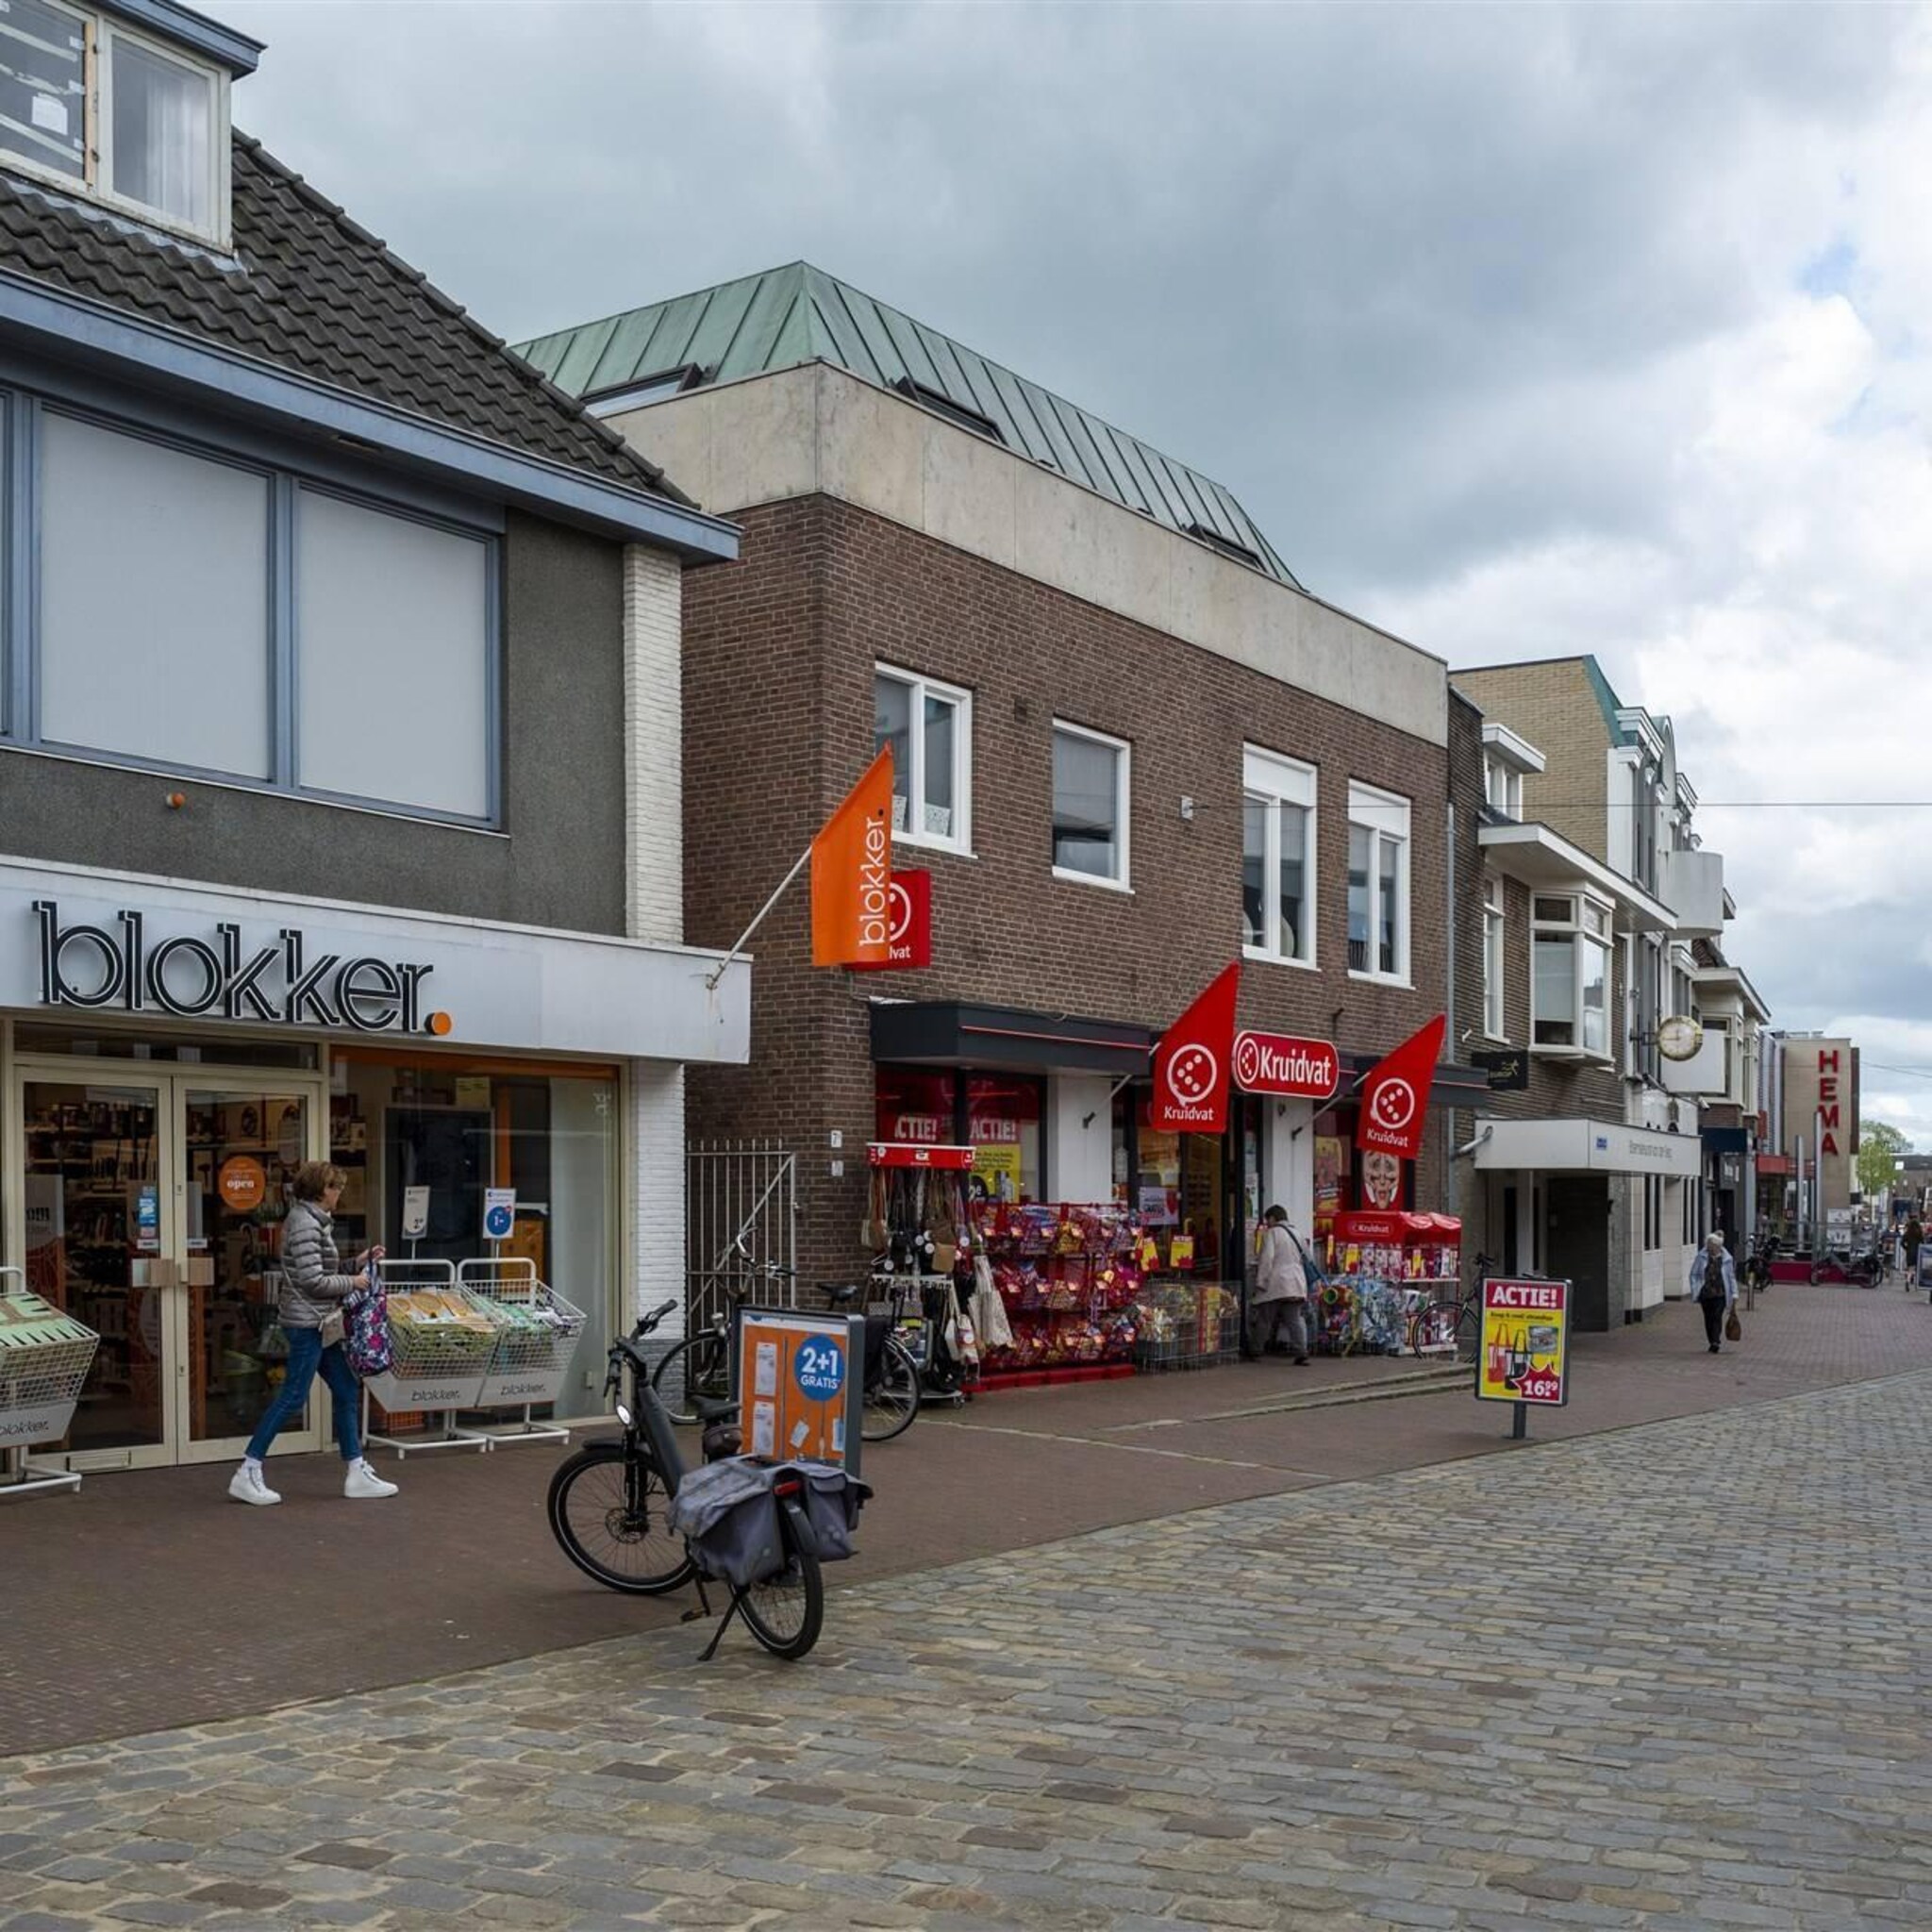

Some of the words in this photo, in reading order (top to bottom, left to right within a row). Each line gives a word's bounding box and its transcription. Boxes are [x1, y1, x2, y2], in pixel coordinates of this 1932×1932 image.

[1260, 1045, 1331, 1085] Kruidvat
[1164, 1105, 1214, 1122] Kruidvat
[1818, 1049, 1839, 1157] HEMA
[970, 1117, 1016, 1141] ACTIE!
[1367, 1128, 1408, 1148] Kruidvat
[226, 1180, 255, 1191] open
[1358, 1222, 1390, 1233] Kruidvat
[1491, 1286, 1557, 1308] ACTIE!
[801, 1347, 839, 1376] 2+1
